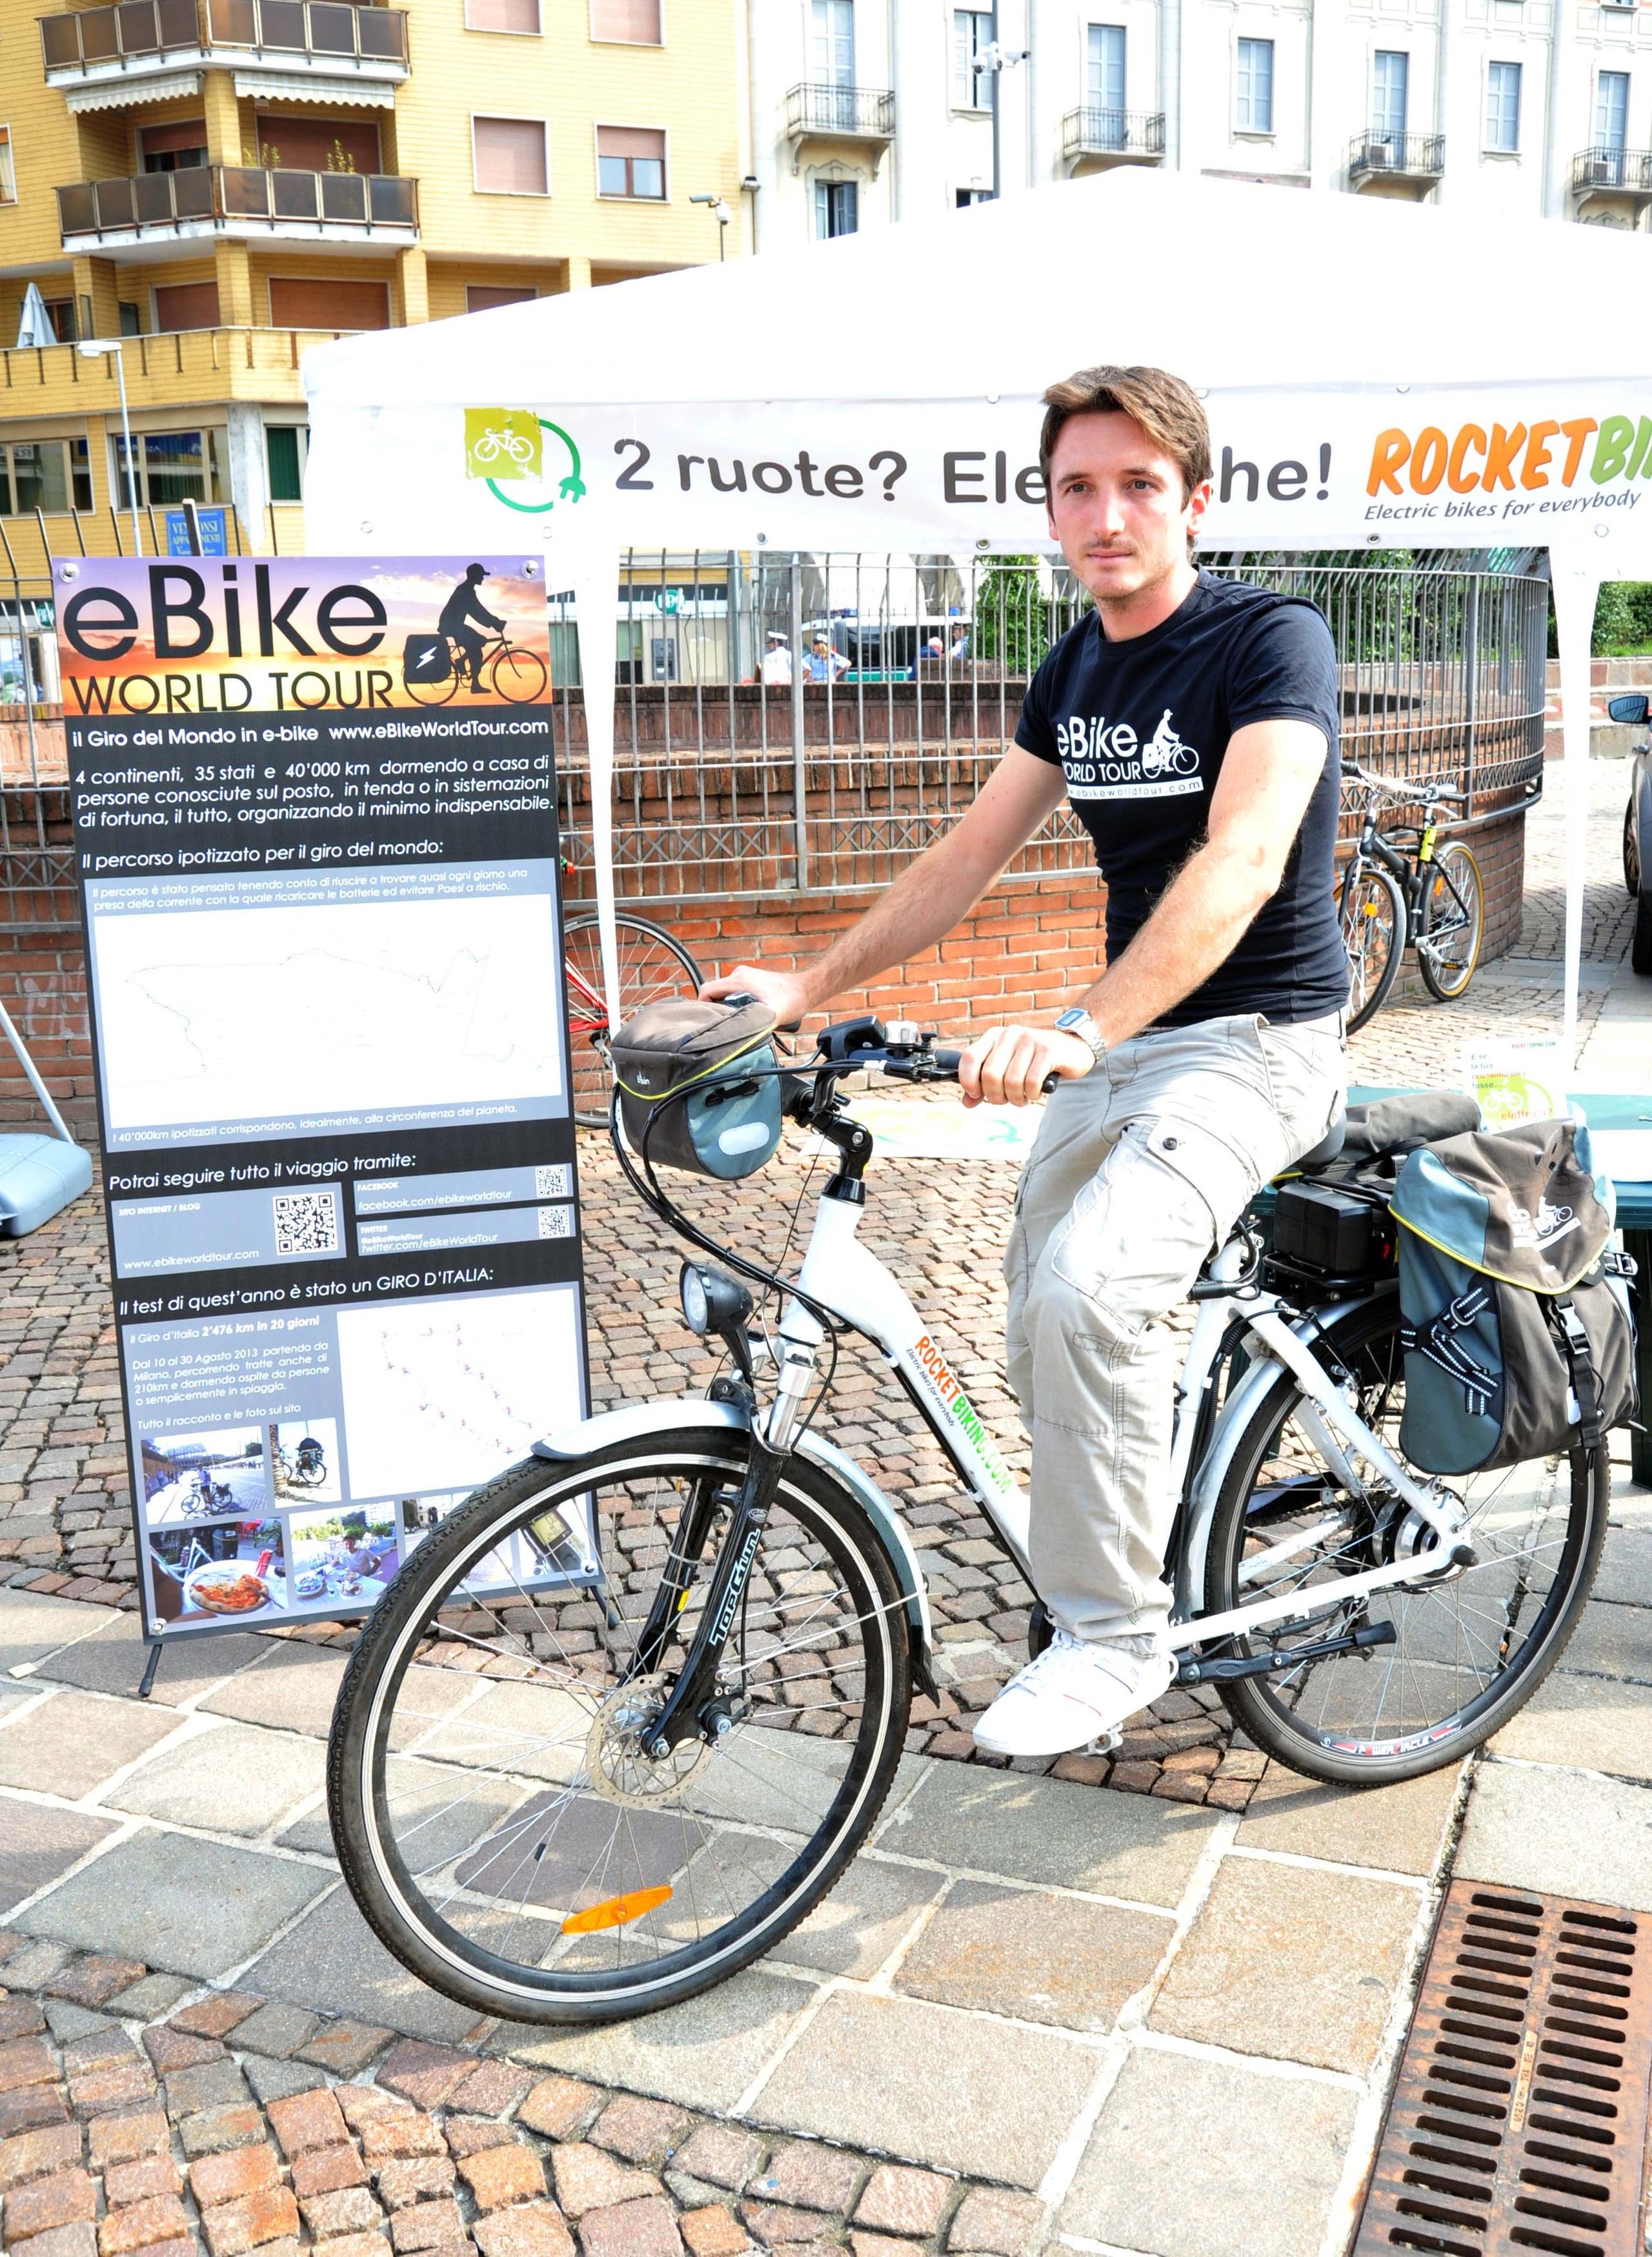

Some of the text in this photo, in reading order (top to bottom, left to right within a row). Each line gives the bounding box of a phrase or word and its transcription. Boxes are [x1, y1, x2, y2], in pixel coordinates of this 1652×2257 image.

[614, 438, 654, 491] 2
[677, 450, 908, 501] ruote?
[1366, 414, 1652, 497] ROCKETBI
[1364, 489, 1642, 521] Electric bikes for everybody
[62, 564, 387, 661] eBike
[70, 670, 393, 714] WORLD TOUR
[72, 720, 548, 747] il Giro del Mondo in e-bike www.eBikeWorldTour.com
[1057, 716, 1138, 759] eBike
[75, 770, 85, 784] 4
[90, 766, 183, 784] continenti,
[194, 765, 214, 781] 35
[219, 764, 255, 780] stati
[264, 767, 276, 778] e
[345, 761, 370, 775] km
[379, 758, 468, 774] dormendo
[472, 760, 484, 771] a
[489, 758, 529, 771] casa
[533, 754, 549, 769] di
[1098, 761, 1142, 782] TOUR
[77, 774, 549, 809] persone conosciute sul posto, in tenda o in sistemazioni
[79, 795, 553, 827] di fortuna, il tutto, organizzando il minimo indispensabile.
[82, 839, 443, 871] Il percorso ipotizzato per il giro del mondo:
[93, 881, 509, 912] presa della corrente con quale ricaricare batterie evitare Paesi rischio.
[100, 887, 148, 898] percorso
[161, 884, 188, 894] stato
[190, 882, 235, 895] pensato
[237, 879, 283, 890] tenendo
[285, 878, 317, 888] conto
[331, 875, 367, 886] riuscire
[379, 874, 416, 884] trovare
[418, 871, 446, 884] quasi
[448, 870, 471, 882] ogni
[507, 869, 527, 878] una
[170, 1125, 217, 1140] ipotizzati
[219, 1121, 297, 1135] corrispondono,
[299, 1115, 361, 1128] idealmente,
[364, 1113, 383, 1124] alla
[385, 1109, 455, 1122] circonferenza
[456, 1106, 474, 1117] del
[475, 1103, 517, 1117] pianeta.
[109, 1153, 416, 1189] Potrai seguire tutto il viaggio tramite:
[358, 1190, 512, 1211] facebook.com/ebikeworldtour
[361, 1233, 499, 1253] twitter.com/eBikeWorldTour
[123, 1250, 259, 1269] www.ebikeworldtour.com
[120, 1301, 127, 1315] Il
[132, 1297, 163, 1313] test
[168, 1295, 183, 1310] di
[290, 1284, 301, 1299] è
[305, 1280, 347, 1297] stato
[352, 1280, 371, 1293] un
[376, 1273, 419, 1290] GIRO
[137, 1333, 160, 1342] Giro
[235, 1322, 254, 1333] km
[256, 1321, 268, 1331] in
[270, 1318, 285, 1330] 20
[287, 1315, 319, 1330] giorni
[132, 1343, 311, 1370] Dal 10 30 Agosto 2013 partendo
[133, 1355, 312, 1382] Milano, percorrendo tratte anche
[134, 1366, 330, 1394] 210km dormendo ospite persone
[145, 1381, 286, 1405] semplicemente spiaggia.
[906, 1348, 956, 1427] Electric bikes for everybody
[137, 1403, 301, 1430] Tutto racconto foto sul sito
